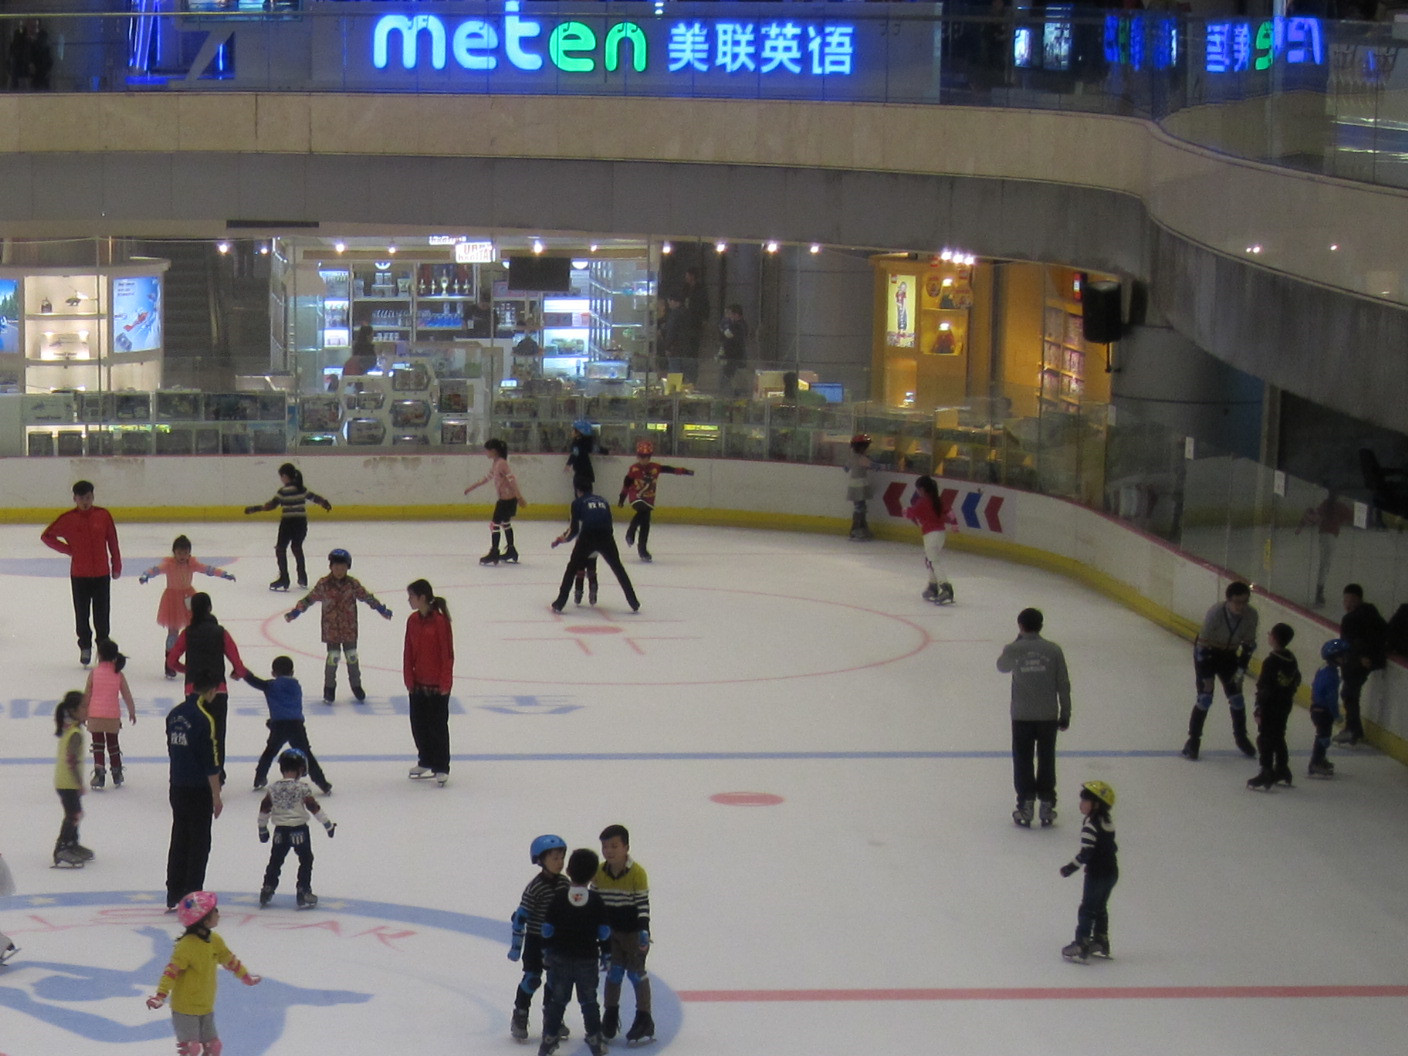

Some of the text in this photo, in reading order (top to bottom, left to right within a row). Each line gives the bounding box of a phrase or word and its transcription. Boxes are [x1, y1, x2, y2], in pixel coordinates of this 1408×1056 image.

[372, 0, 648, 72] meten
[667, 22, 856, 75] 美联英语
